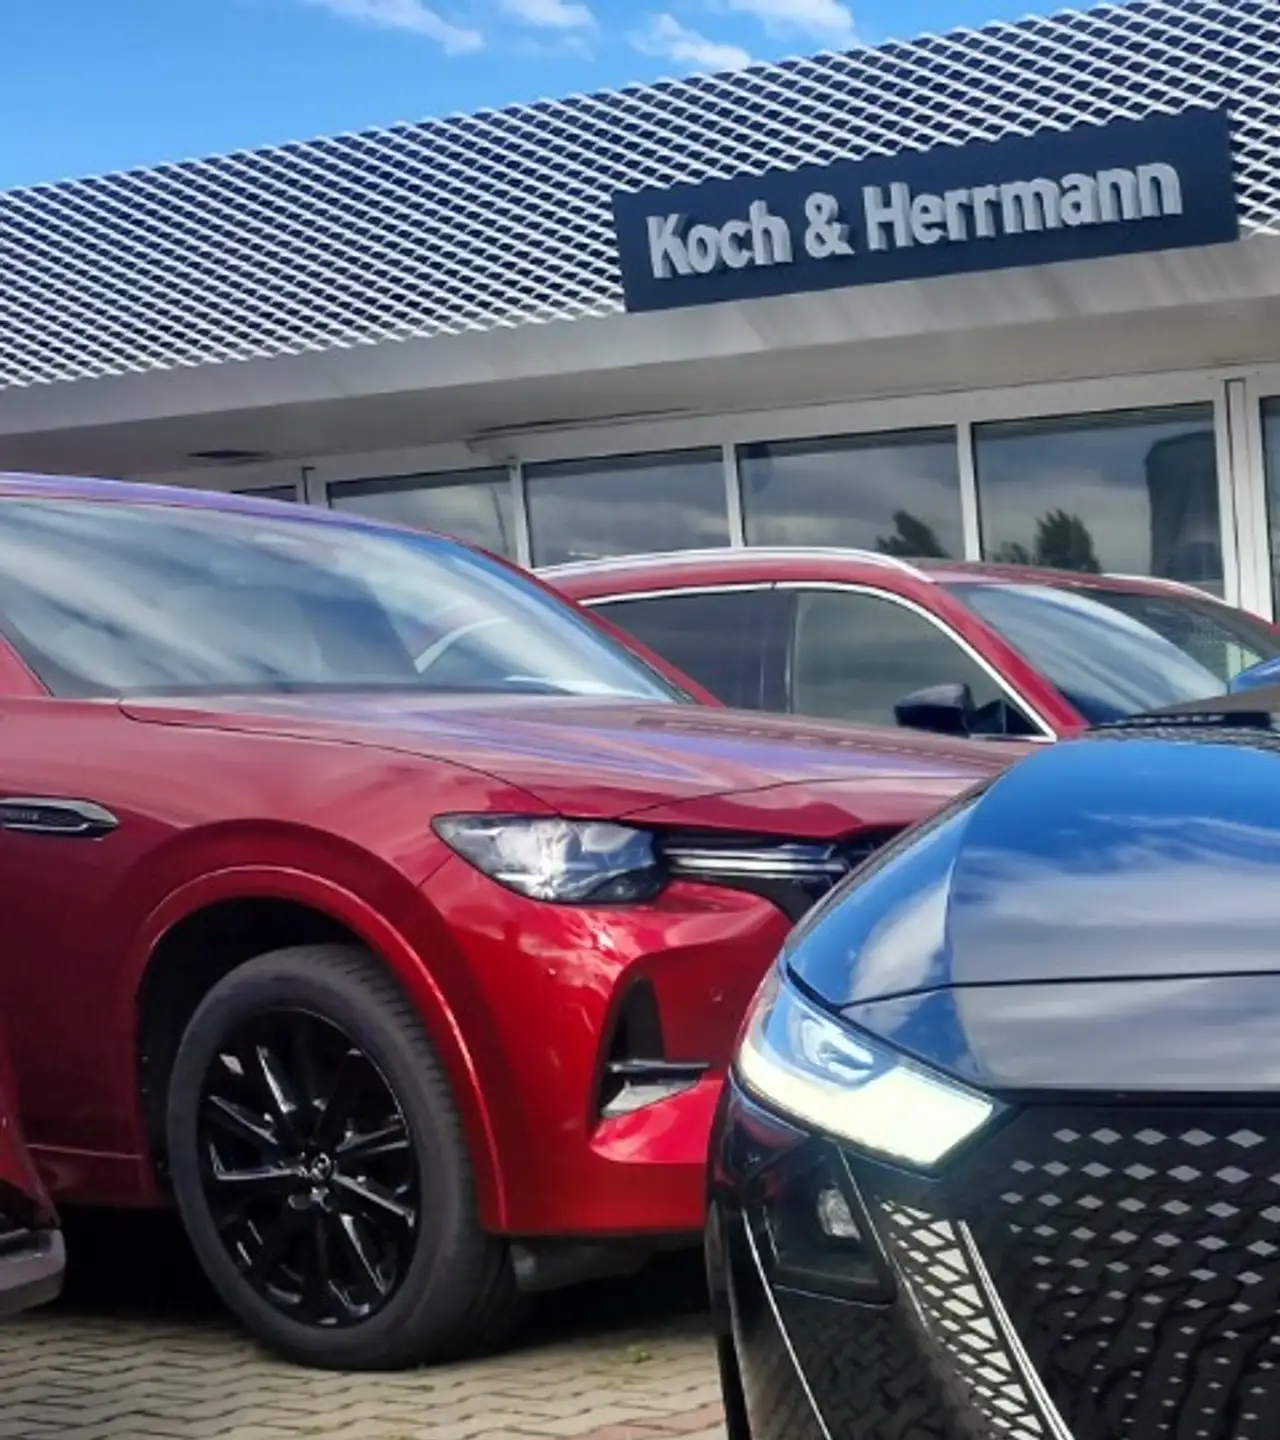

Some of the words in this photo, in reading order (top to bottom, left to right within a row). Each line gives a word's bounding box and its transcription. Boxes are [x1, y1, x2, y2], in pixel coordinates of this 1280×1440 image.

[646, 200, 793, 278] Koch
[804, 191, 855, 258] &
[861, 162, 1183, 251] Herrmann
